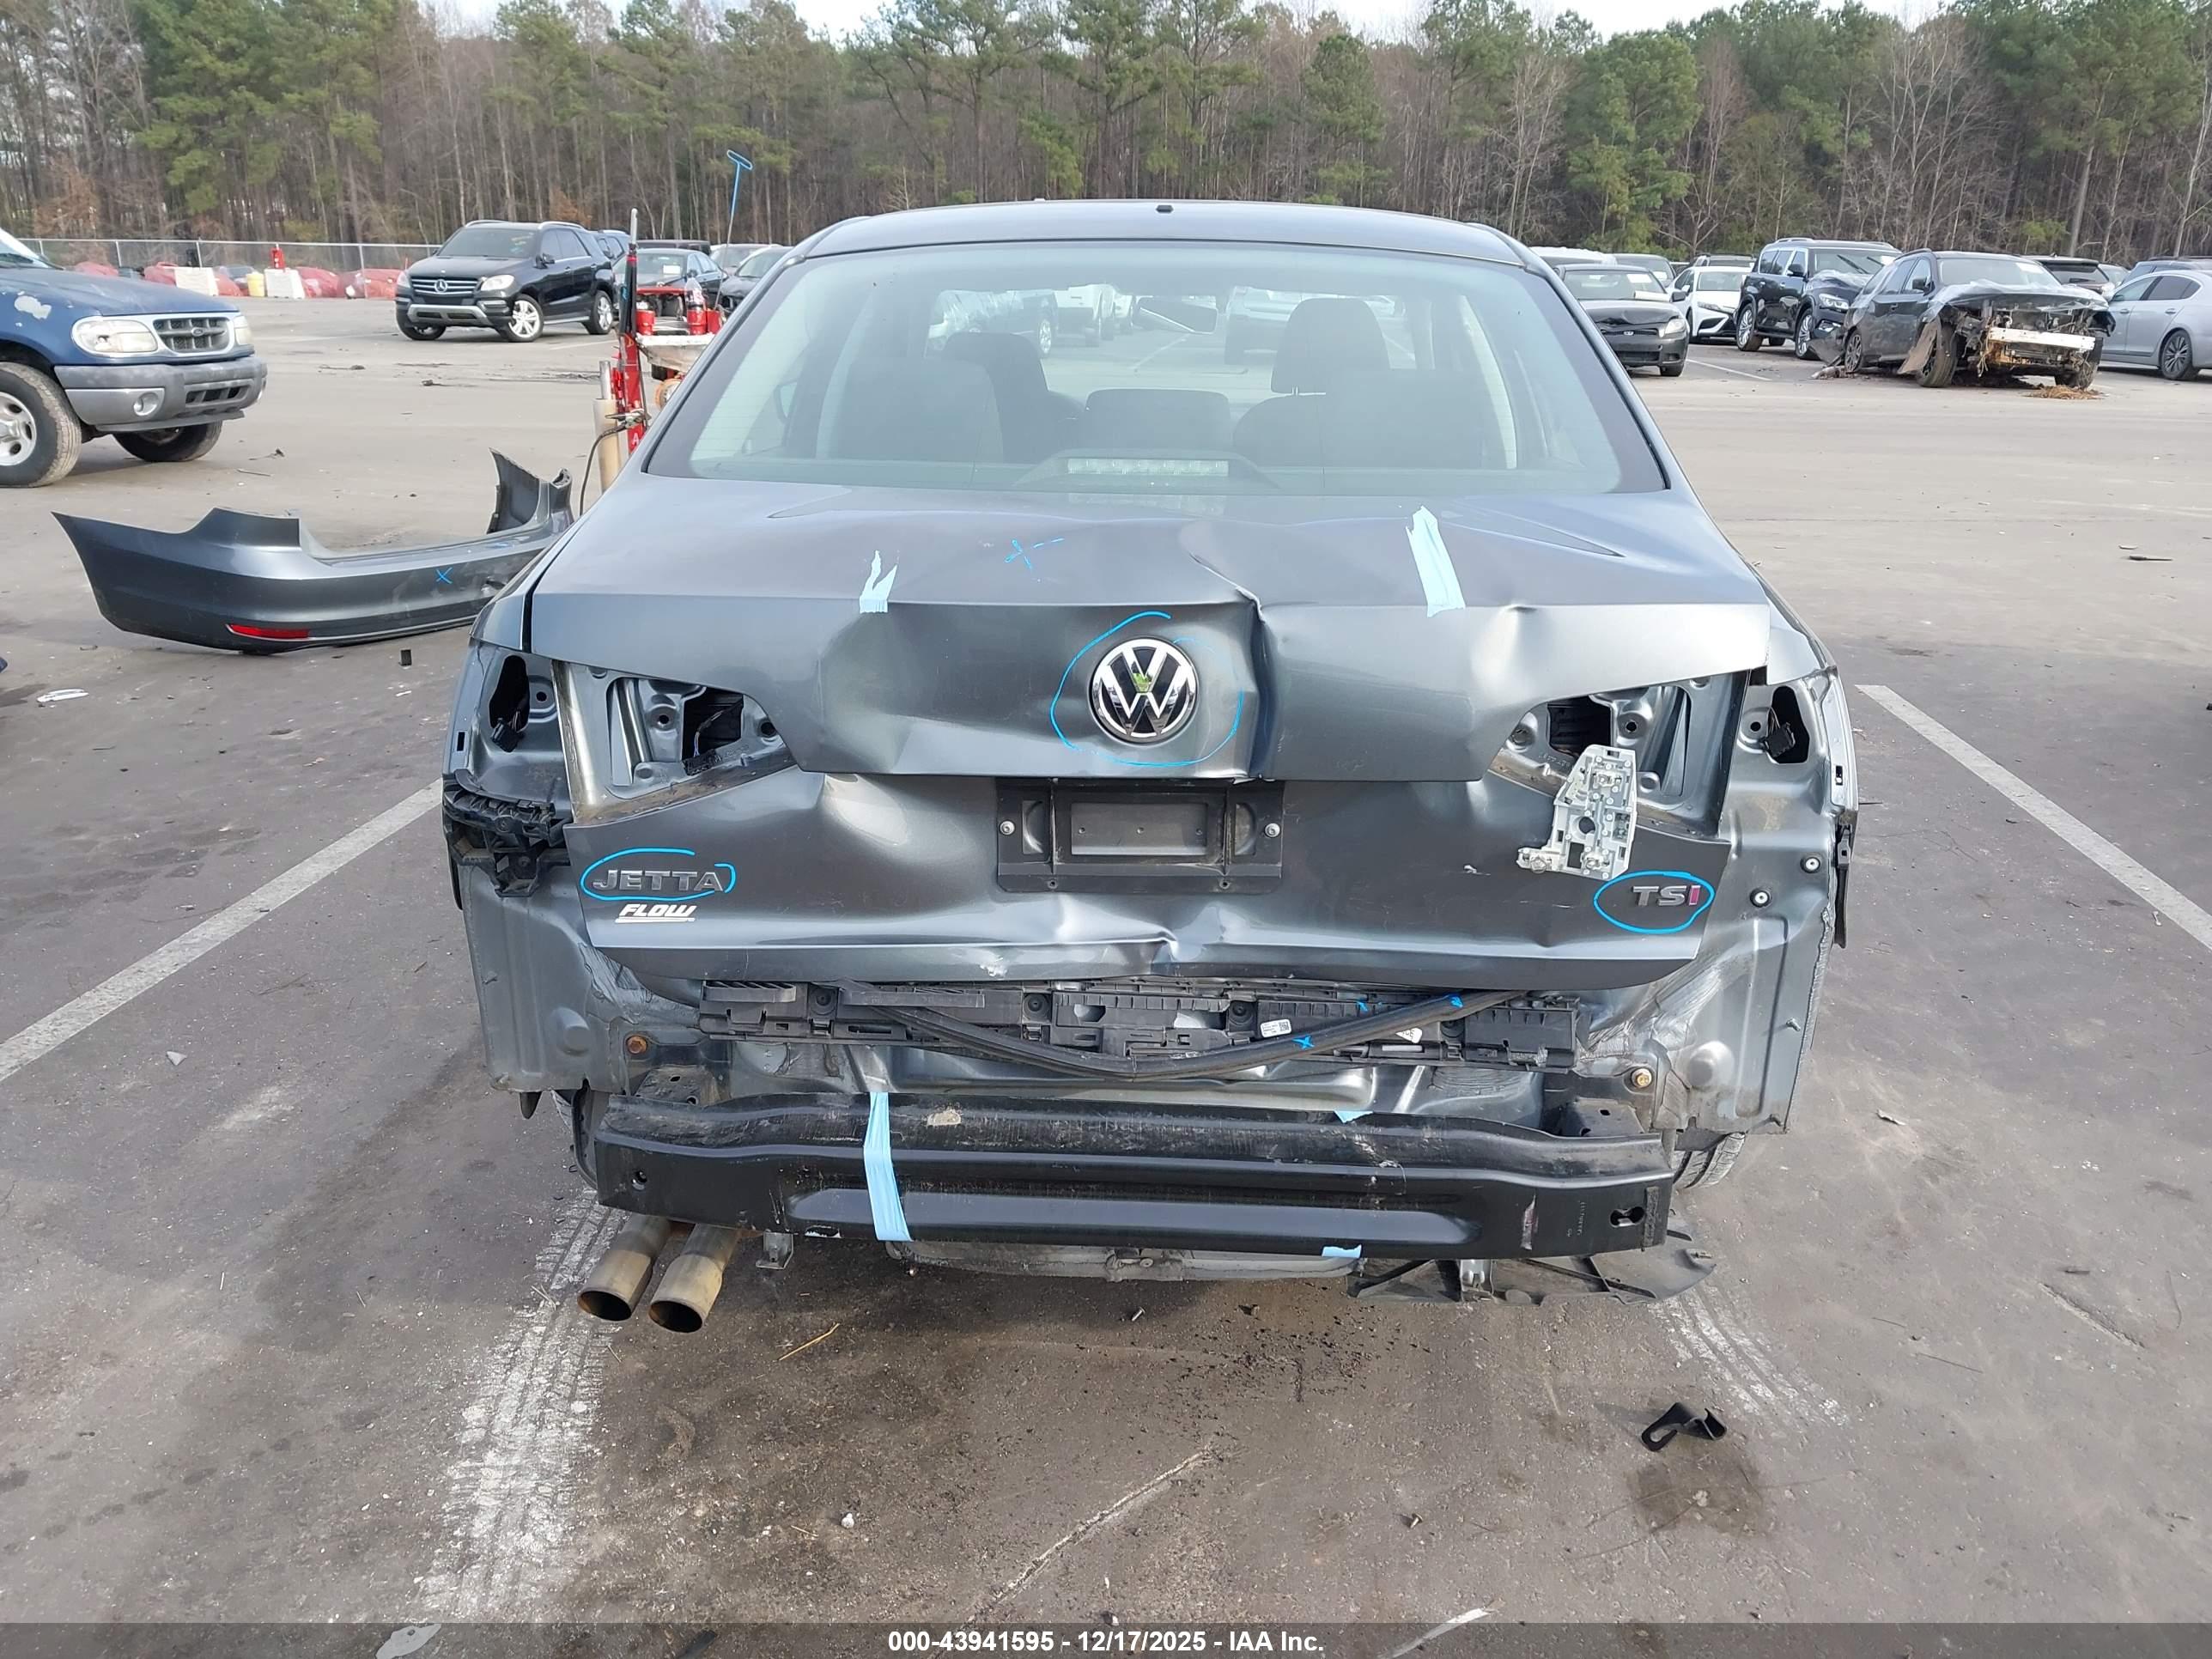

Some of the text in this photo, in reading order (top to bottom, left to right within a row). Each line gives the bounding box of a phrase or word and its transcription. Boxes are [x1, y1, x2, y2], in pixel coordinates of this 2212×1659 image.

[592, 869, 724, 892] JETTA
[1632, 884, 1701, 906] TSI
[618, 903, 697, 917] FLOW
